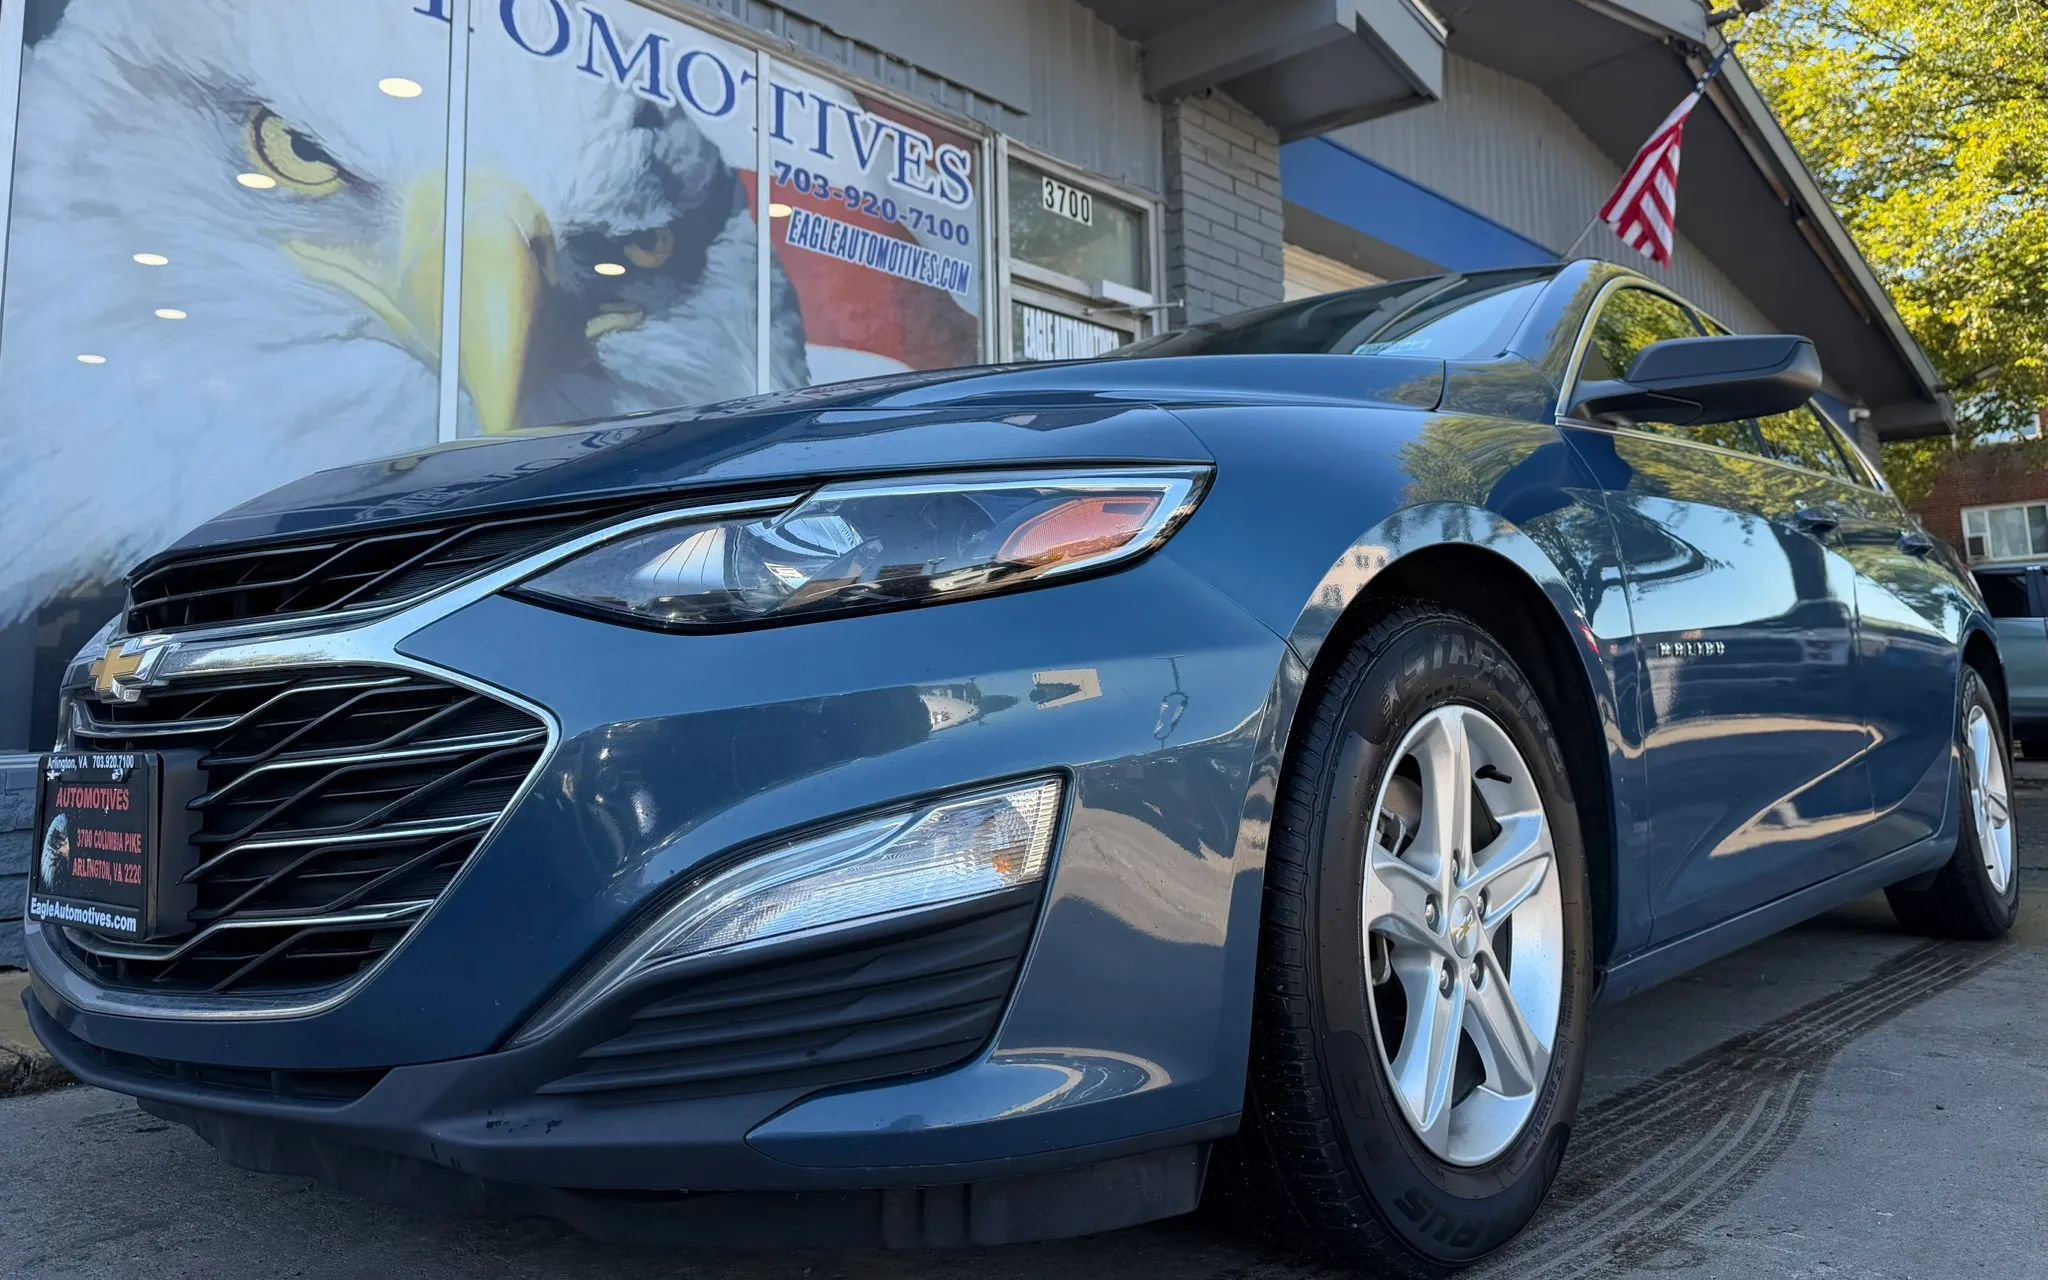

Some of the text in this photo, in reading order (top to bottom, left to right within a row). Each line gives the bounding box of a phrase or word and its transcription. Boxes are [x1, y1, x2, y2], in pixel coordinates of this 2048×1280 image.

[774, 160, 970, 246] 703-920-7100
[1045, 181, 1091, 224] 3700
[788, 210, 971, 294] EAGLEAUTOMOTIVES.COM
[1656, 641, 1725, 656] MALIBU
[47, 755, 134, 772] Arlington, VA 703.920.7100
[56, 787, 129, 811] AUTOMOTIVES
[76, 828, 142, 854] 3700 COLUMBIA PIKE
[72, 857, 112, 885] ARLINGTON,
[113, 862, 123, 882] VA
[30, 898, 137, 932] EagleAutomotives.com
